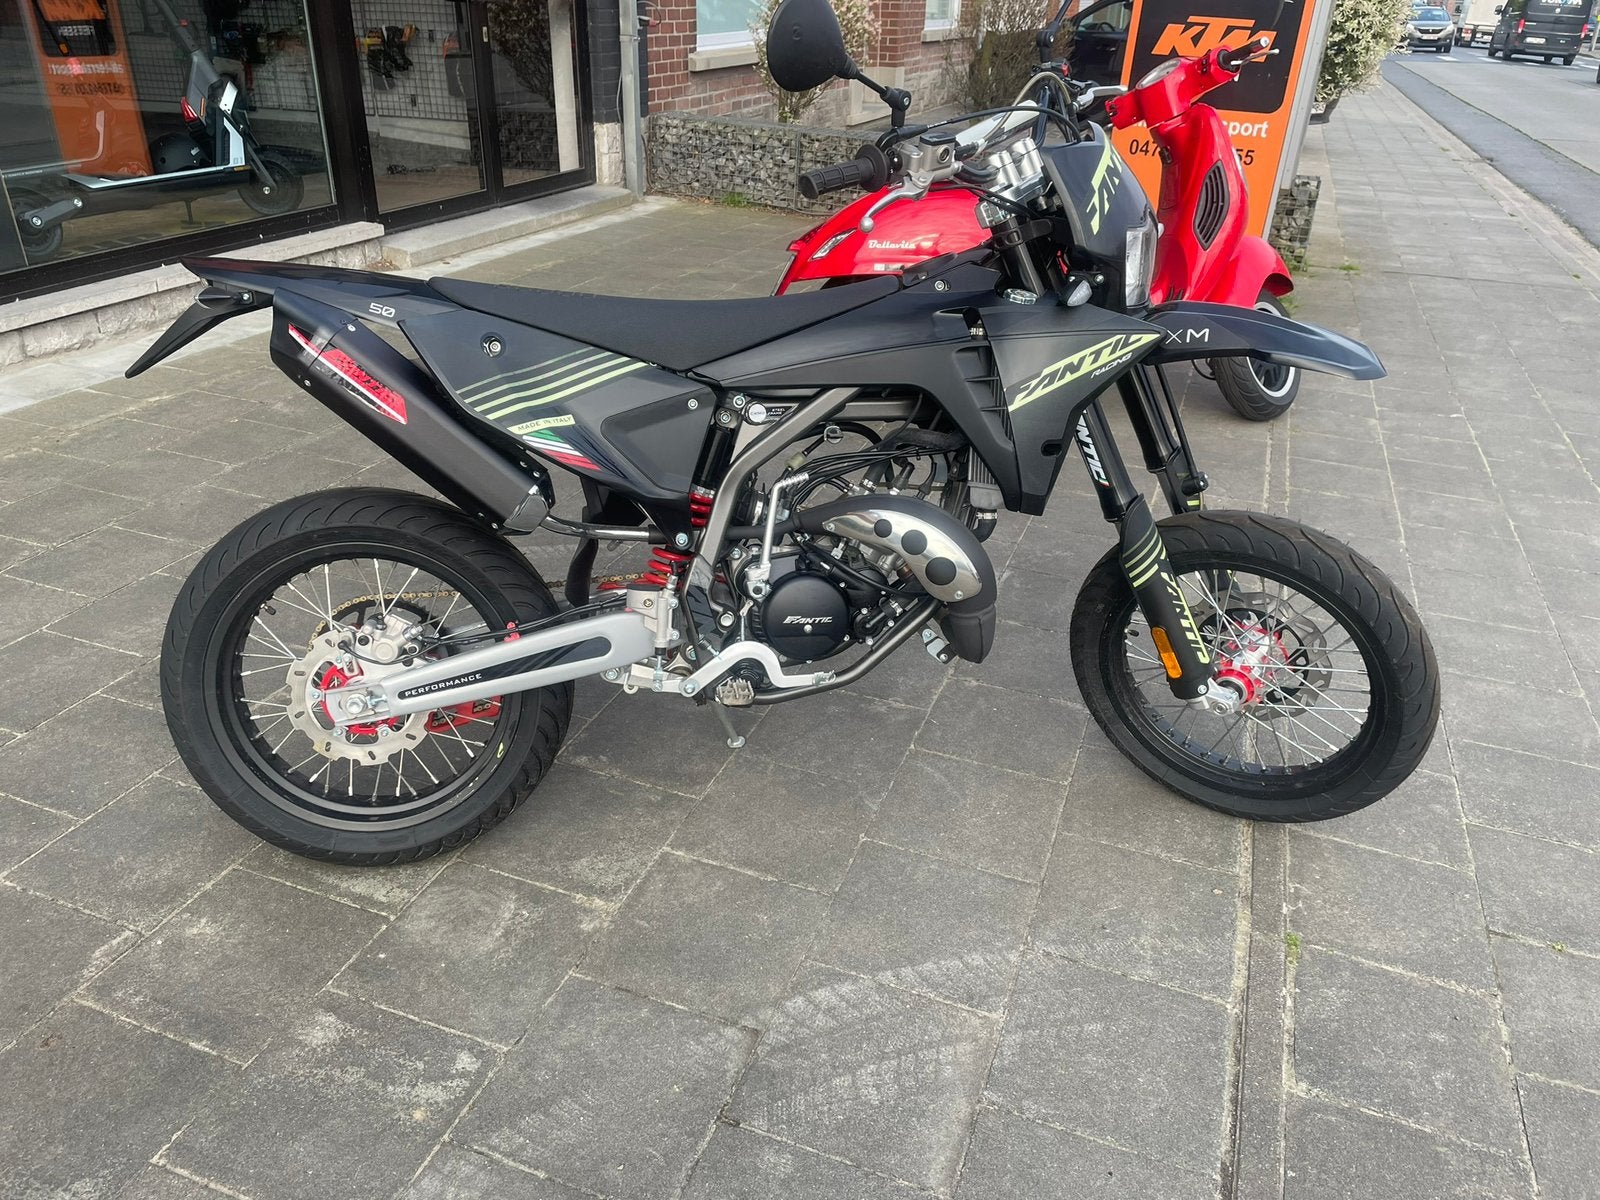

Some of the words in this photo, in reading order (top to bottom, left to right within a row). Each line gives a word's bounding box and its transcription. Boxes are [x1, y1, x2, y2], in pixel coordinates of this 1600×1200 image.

[1151, 16, 1277, 62] KTM
[368, 302, 396, 318] 50
[1165, 327, 1210, 344] XM
[1090, 352, 1133, 379] RACING
[517, 420, 542, 432] MADE
[552, 416, 573, 425] ITALY
[783, 615, 833, 624] FANTIC
[404, 673, 482, 697] PERFORMANCE
